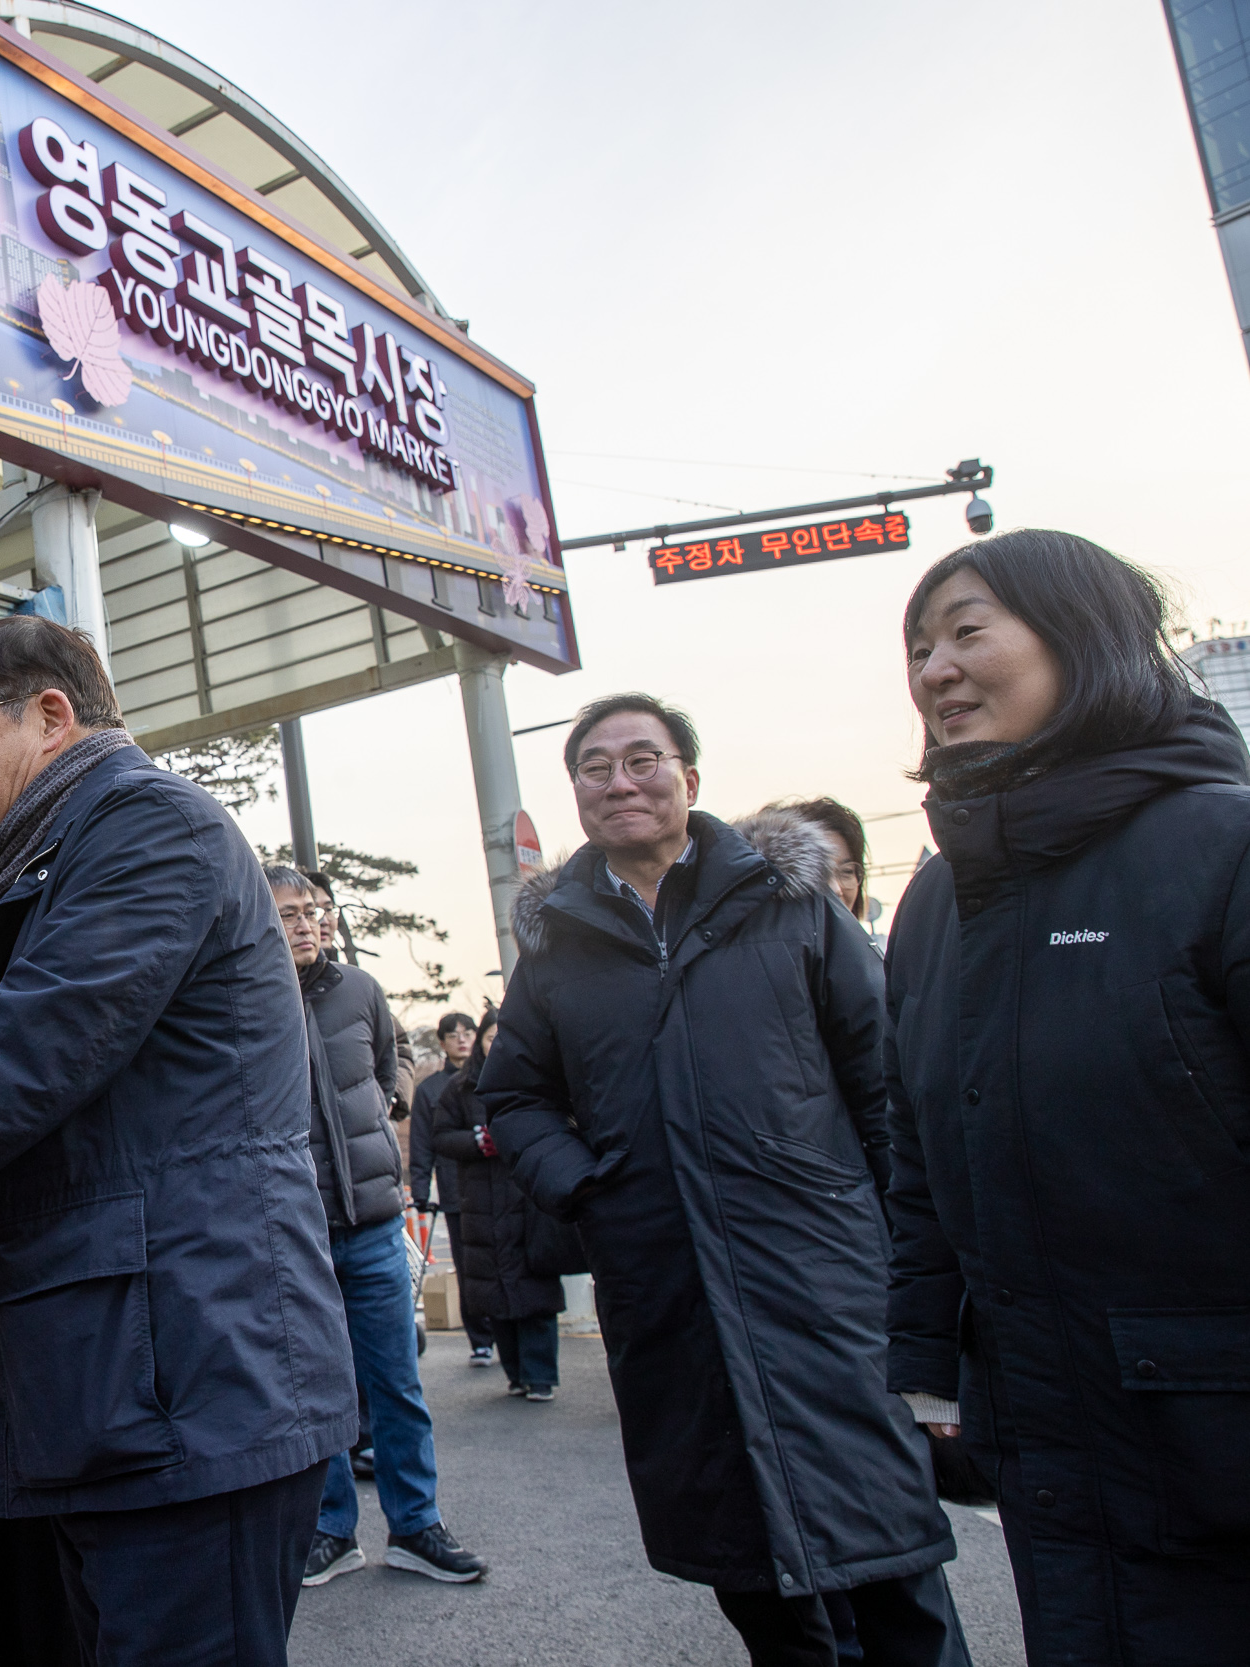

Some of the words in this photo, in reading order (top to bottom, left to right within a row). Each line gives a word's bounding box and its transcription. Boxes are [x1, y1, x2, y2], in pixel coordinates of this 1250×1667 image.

[32, 117, 448, 446] 영동교골목시장
[111, 268, 363, 438] YOUNGDONGGYO
[367, 410, 459, 490] MARKET
[655, 537, 745, 574] 주정차
[1049, 929, 1107, 945] Dickies
